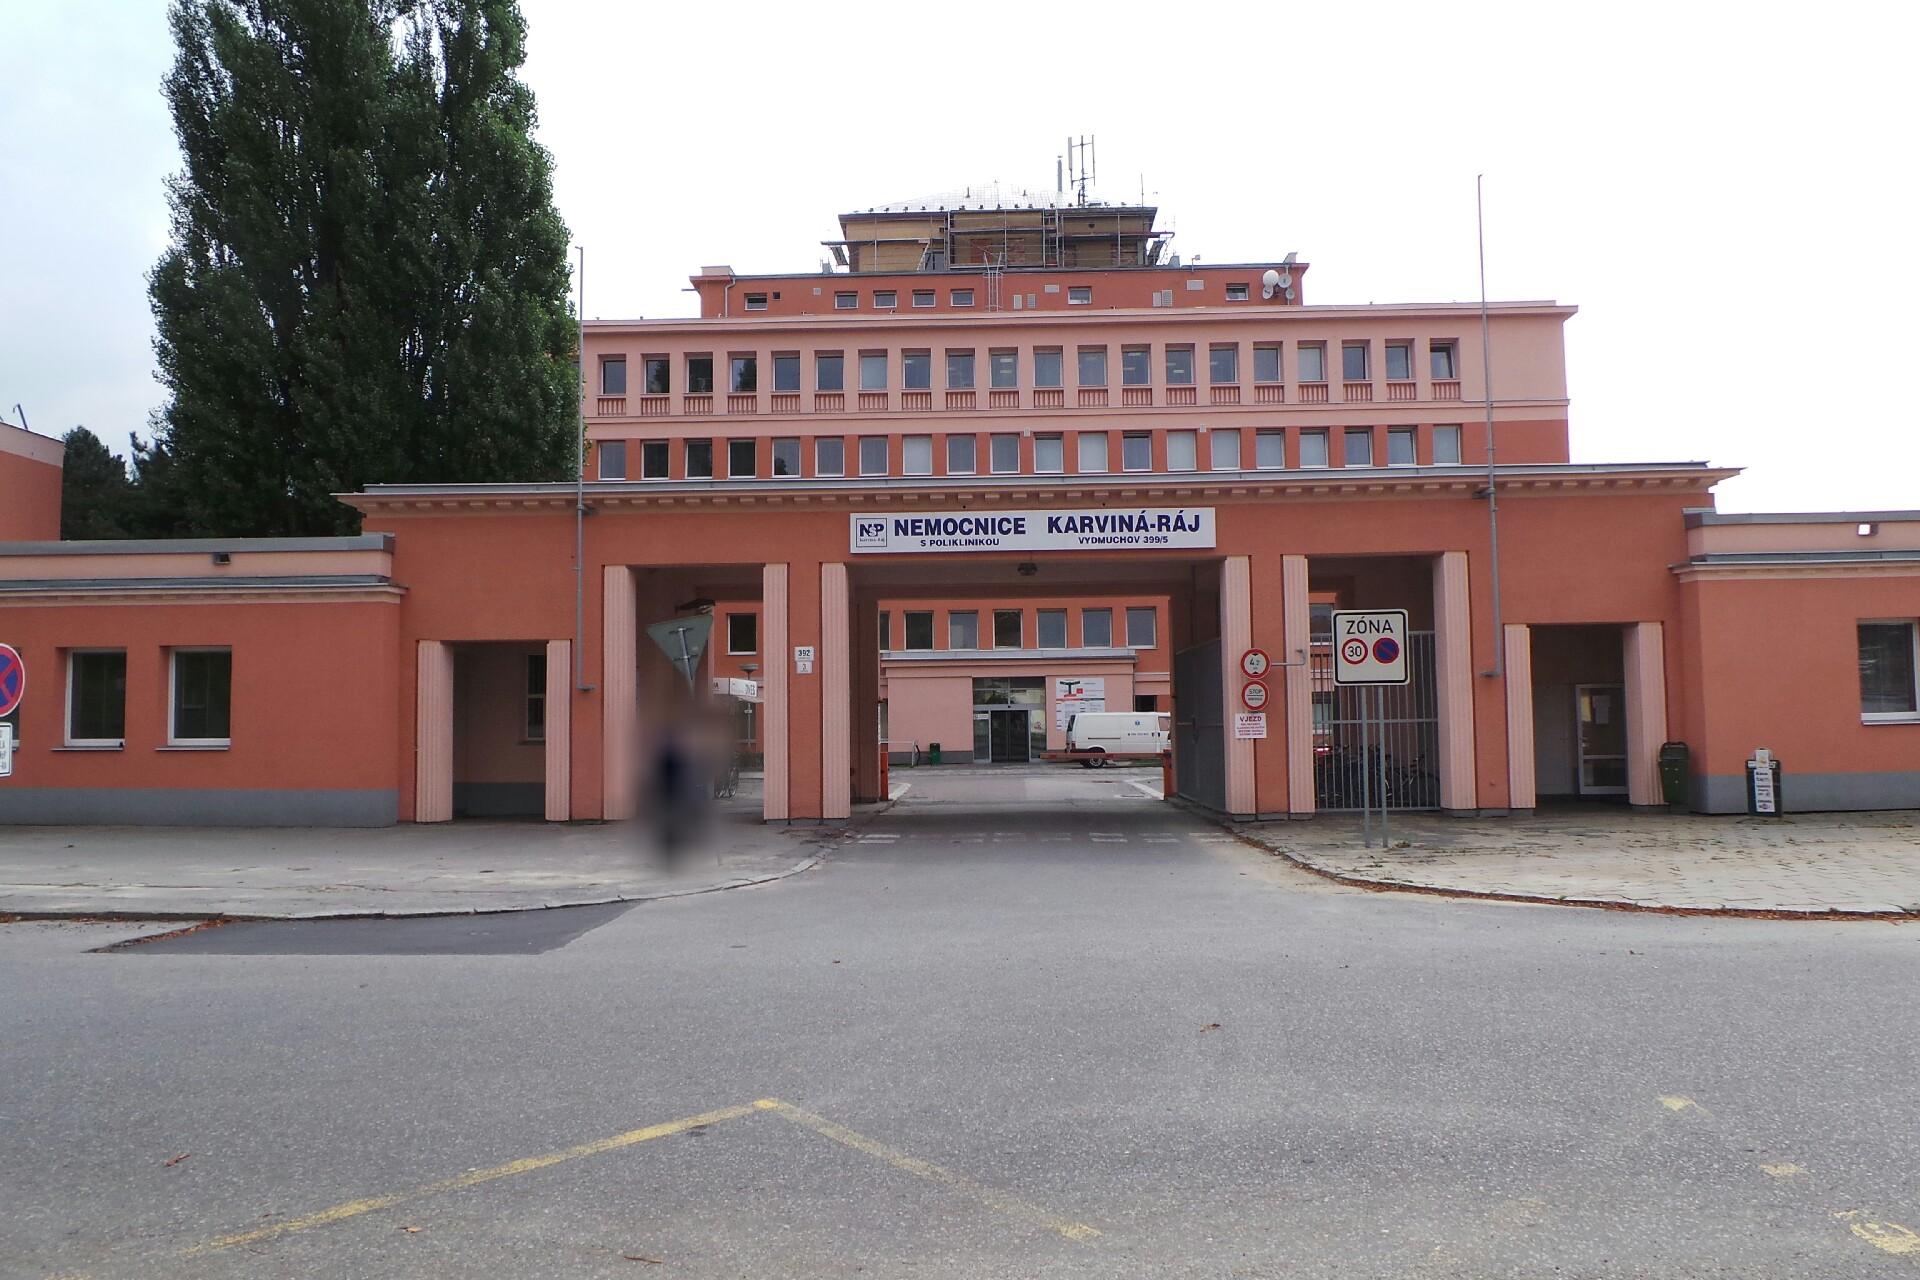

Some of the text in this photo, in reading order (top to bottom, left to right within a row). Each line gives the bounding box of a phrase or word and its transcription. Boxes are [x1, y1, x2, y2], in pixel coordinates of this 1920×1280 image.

[894, 510, 1200, 536] NEMOCNICE KARVINÁ-RÁJ
[920, 538, 1000, 547] S POLIKLINIKOU
[1078, 535, 1169, 544] VYDMUCHOV 399/5
[1346, 616, 1394, 635] ZÓNA
[1347, 646, 1362, 657] 30
